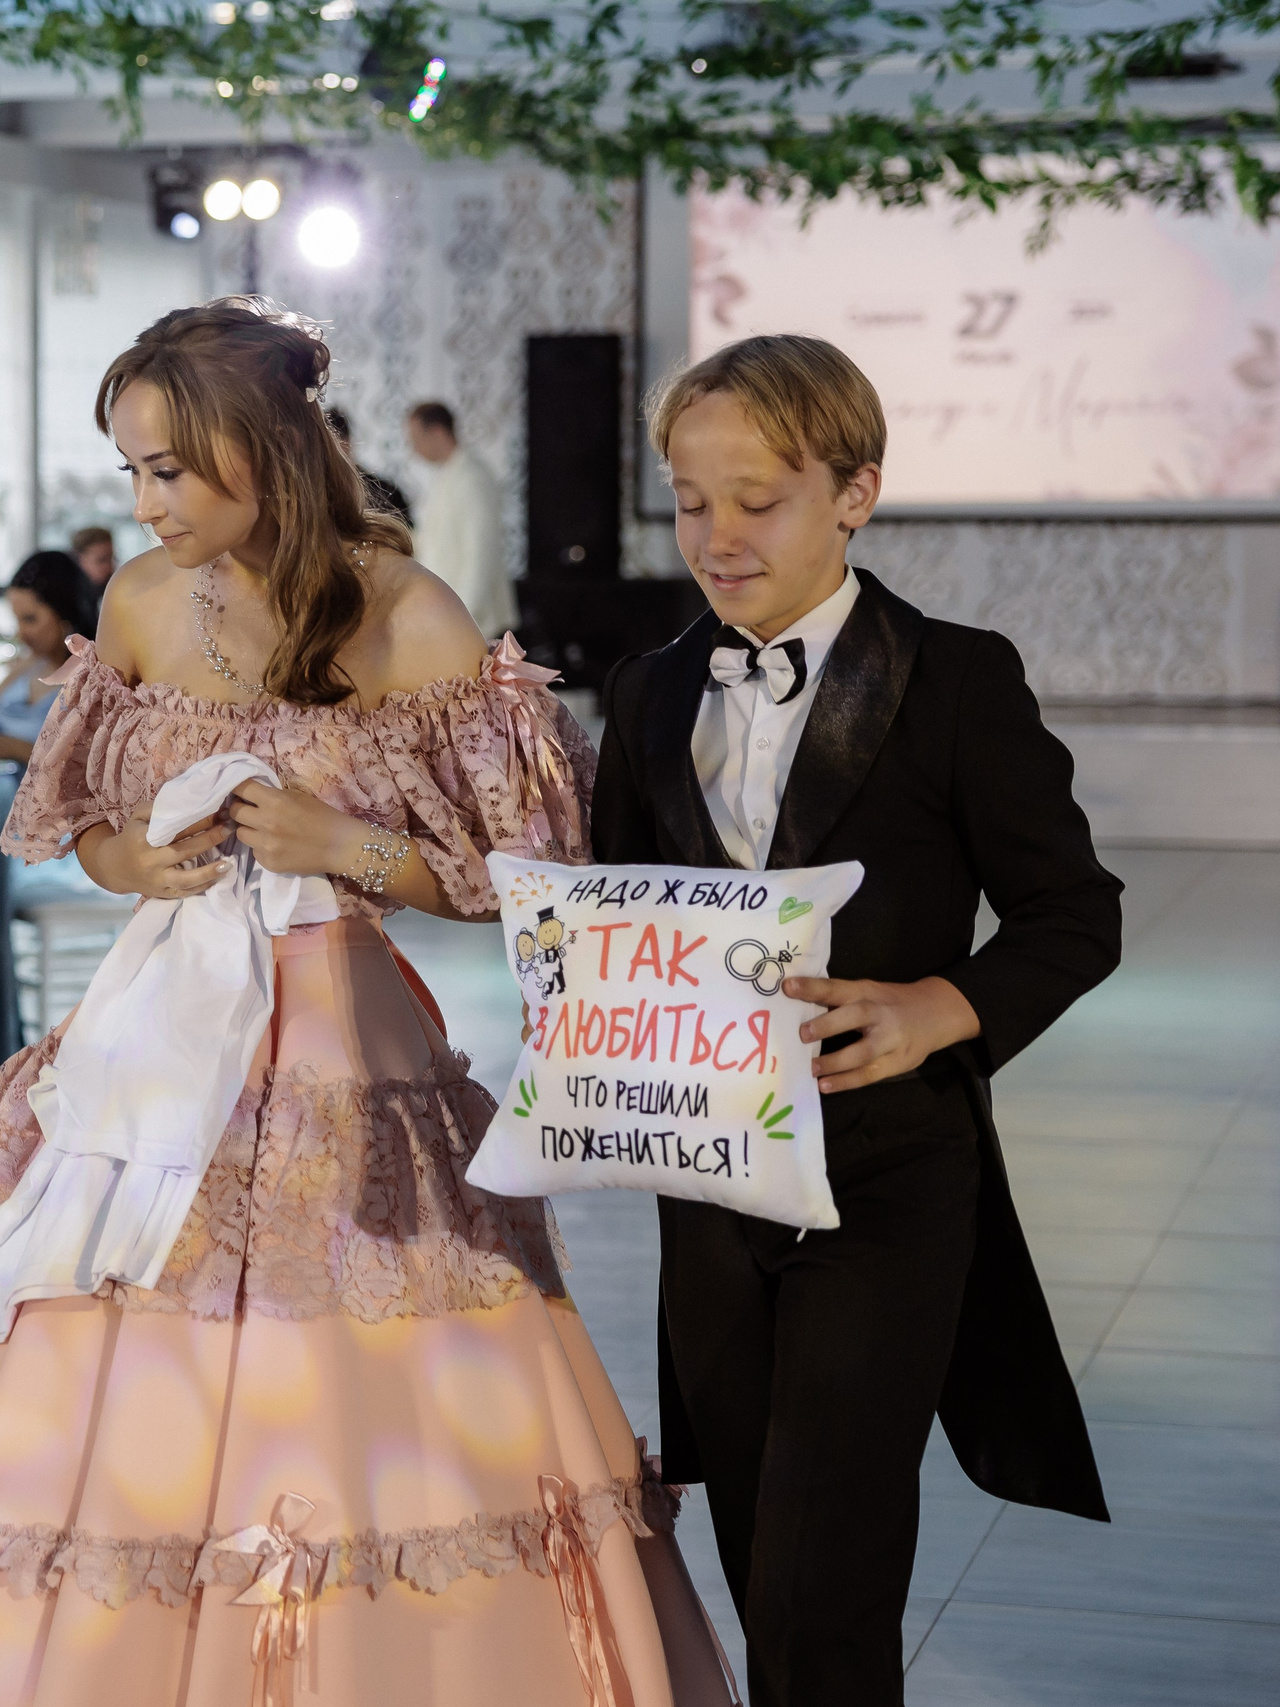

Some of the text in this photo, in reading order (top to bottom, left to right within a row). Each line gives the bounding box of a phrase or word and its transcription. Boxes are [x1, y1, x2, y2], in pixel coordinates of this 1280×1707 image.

[956, 292, 1018, 340] 27
[567, 877, 768, 911] НАДО Ж БЫЛО
[587, 922, 708, 987] ТАК
[567, 1076, 708, 1118] ЧТО РЕШИЛИ
